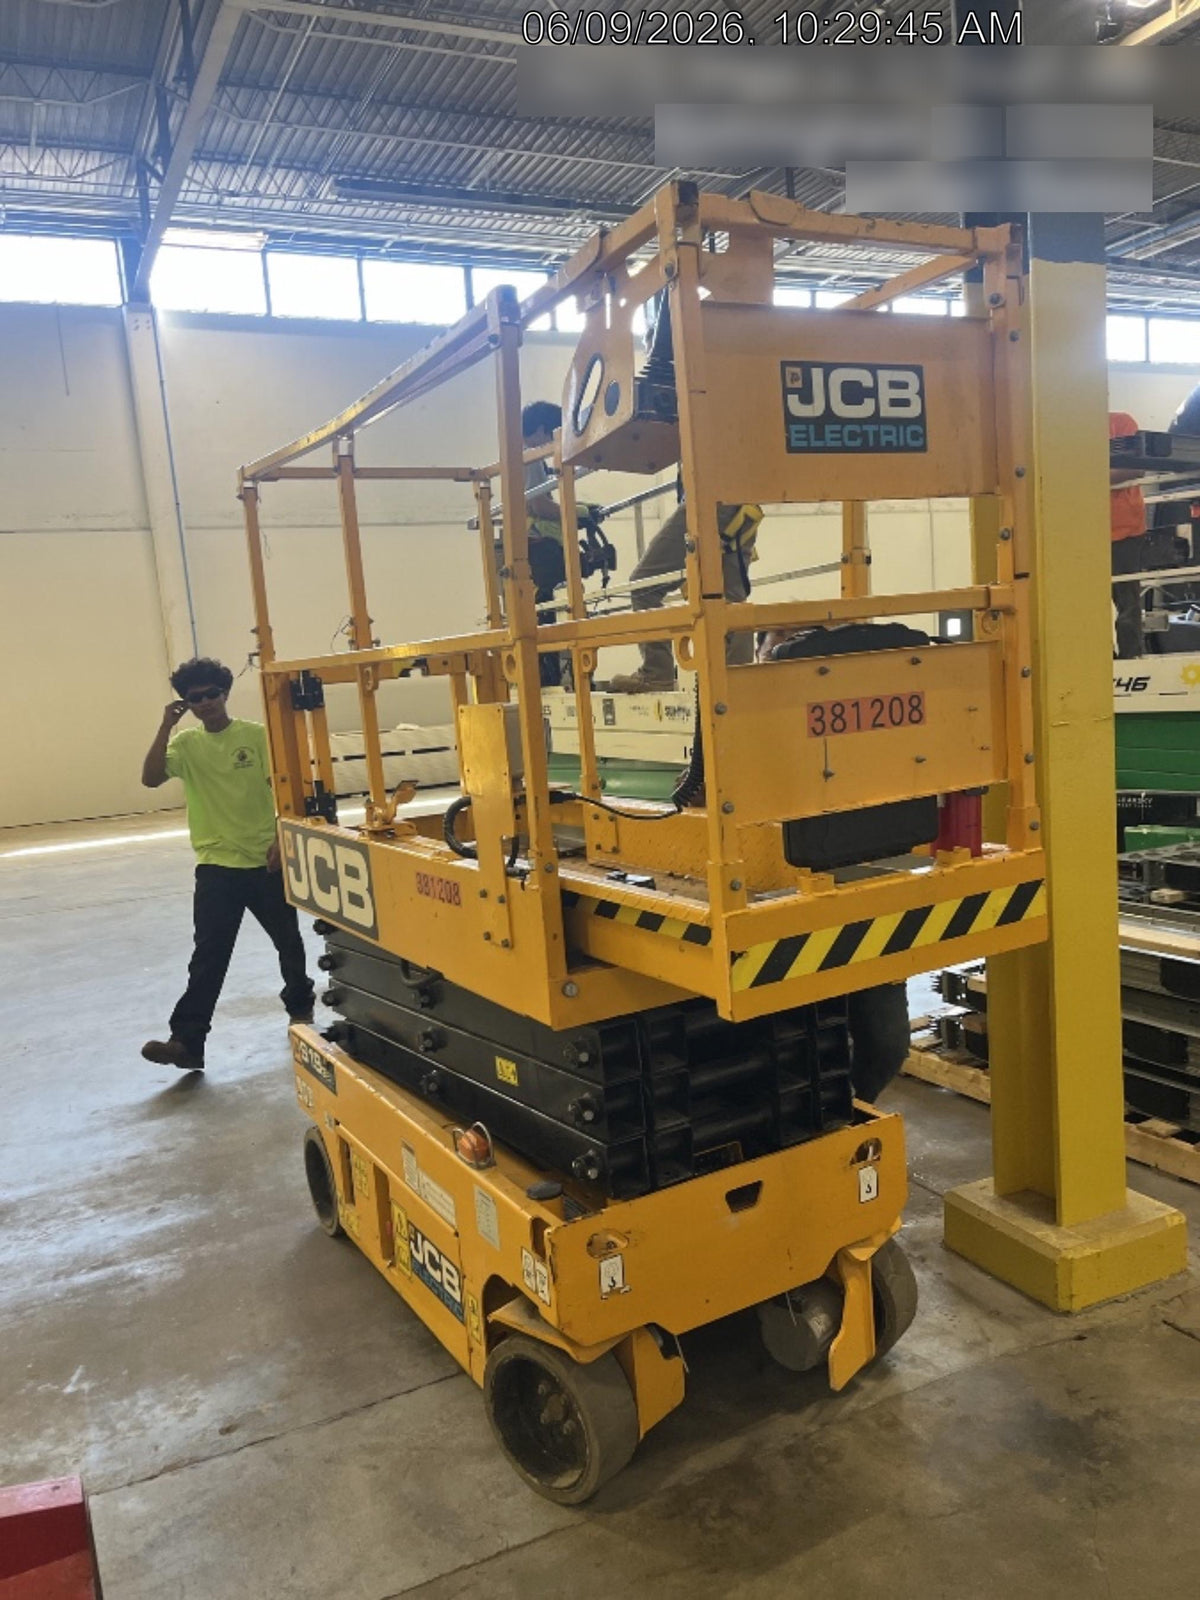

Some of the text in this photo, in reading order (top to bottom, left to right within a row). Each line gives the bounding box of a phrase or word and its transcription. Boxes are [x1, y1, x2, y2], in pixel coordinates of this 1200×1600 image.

[787, 367, 922, 418] JCB
[789, 424, 924, 447] ELECTRIC
[1113, 676, 1151, 691] 46
[810, 695, 923, 736] 381208
[288, 833, 374, 928] JCB
[416, 872, 461, 906] 381208
[410, 1230, 460, 1303] JCB
